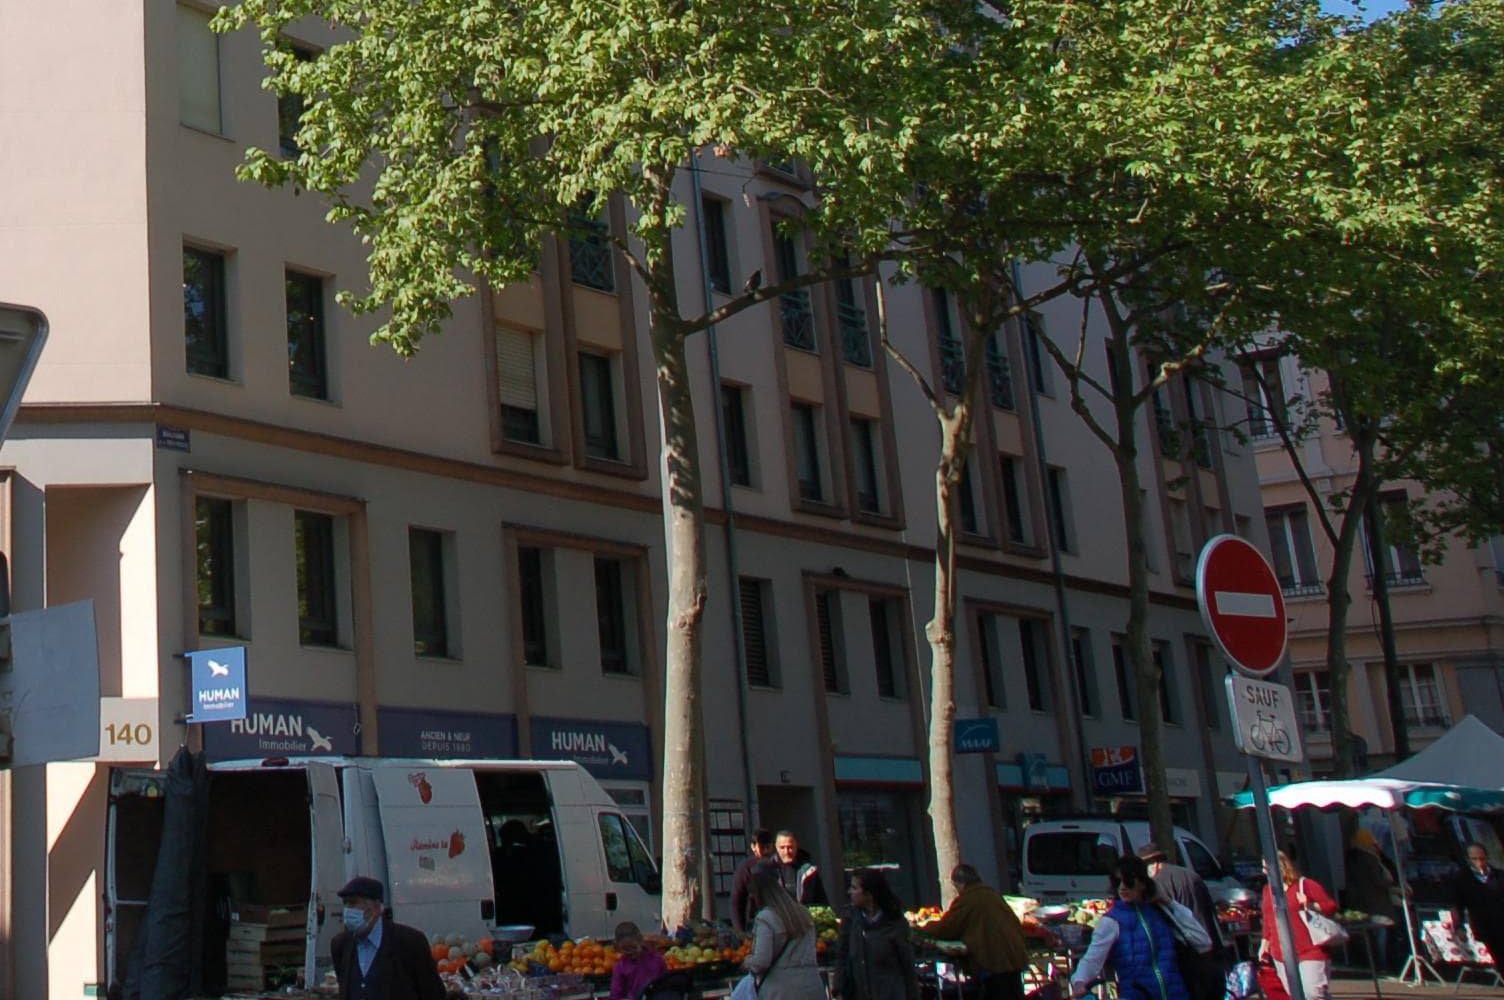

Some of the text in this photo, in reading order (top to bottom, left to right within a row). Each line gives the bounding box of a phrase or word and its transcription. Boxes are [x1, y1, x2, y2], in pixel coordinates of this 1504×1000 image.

[198, 687, 240, 702] HUMAN
[1246, 685, 1279, 708] SAUF
[104, 723, 152, 745] 140
[231, 712, 303, 737] HUMAN
[258, 738, 308, 752] Immobilier
[551, 730, 606, 752] HUMAN
[1098, 770, 1135, 787] GMF
